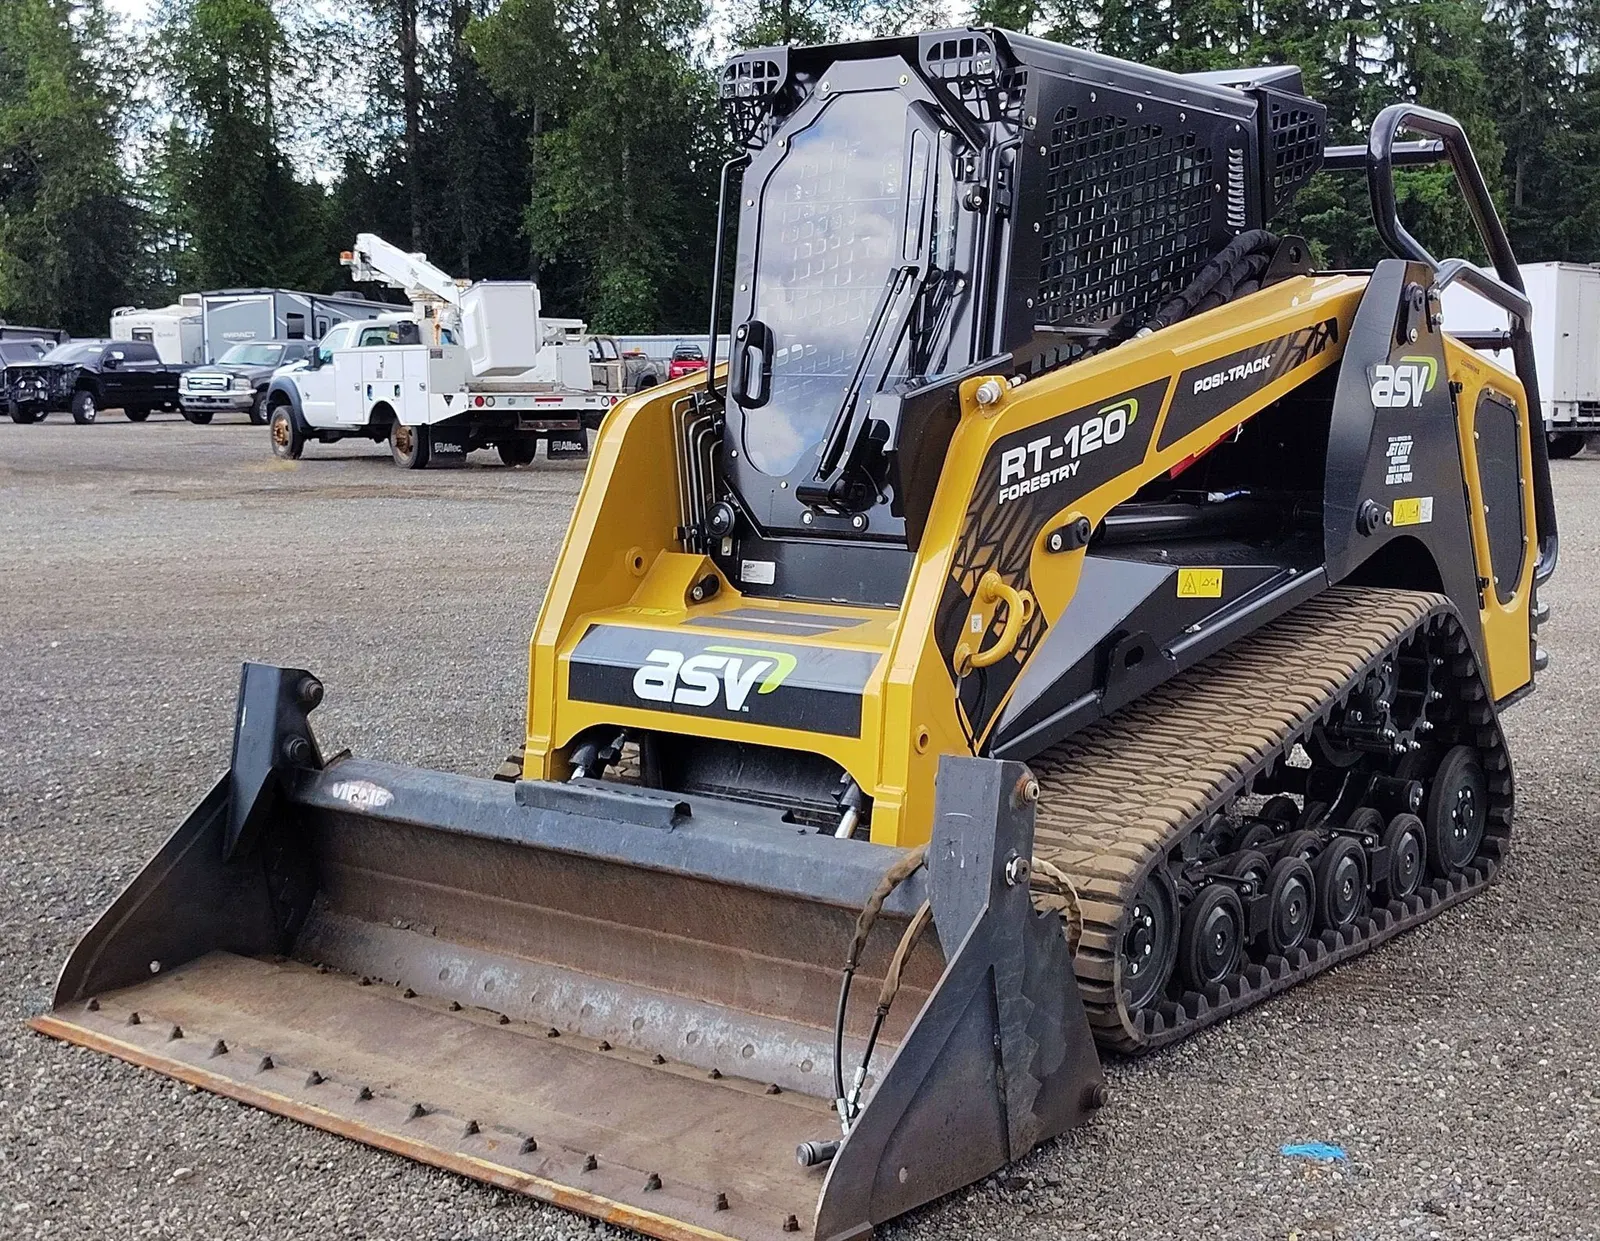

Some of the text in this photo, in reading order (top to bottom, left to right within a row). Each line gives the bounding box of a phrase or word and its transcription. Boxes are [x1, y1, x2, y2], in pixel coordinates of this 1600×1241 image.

[222, 331, 257, 340] IMPACT
[1193, 354, 1272, 395] POSI-TRACK
[999, 409, 1127, 486] RT-120
[998, 460, 1081, 505] FORESTRY
